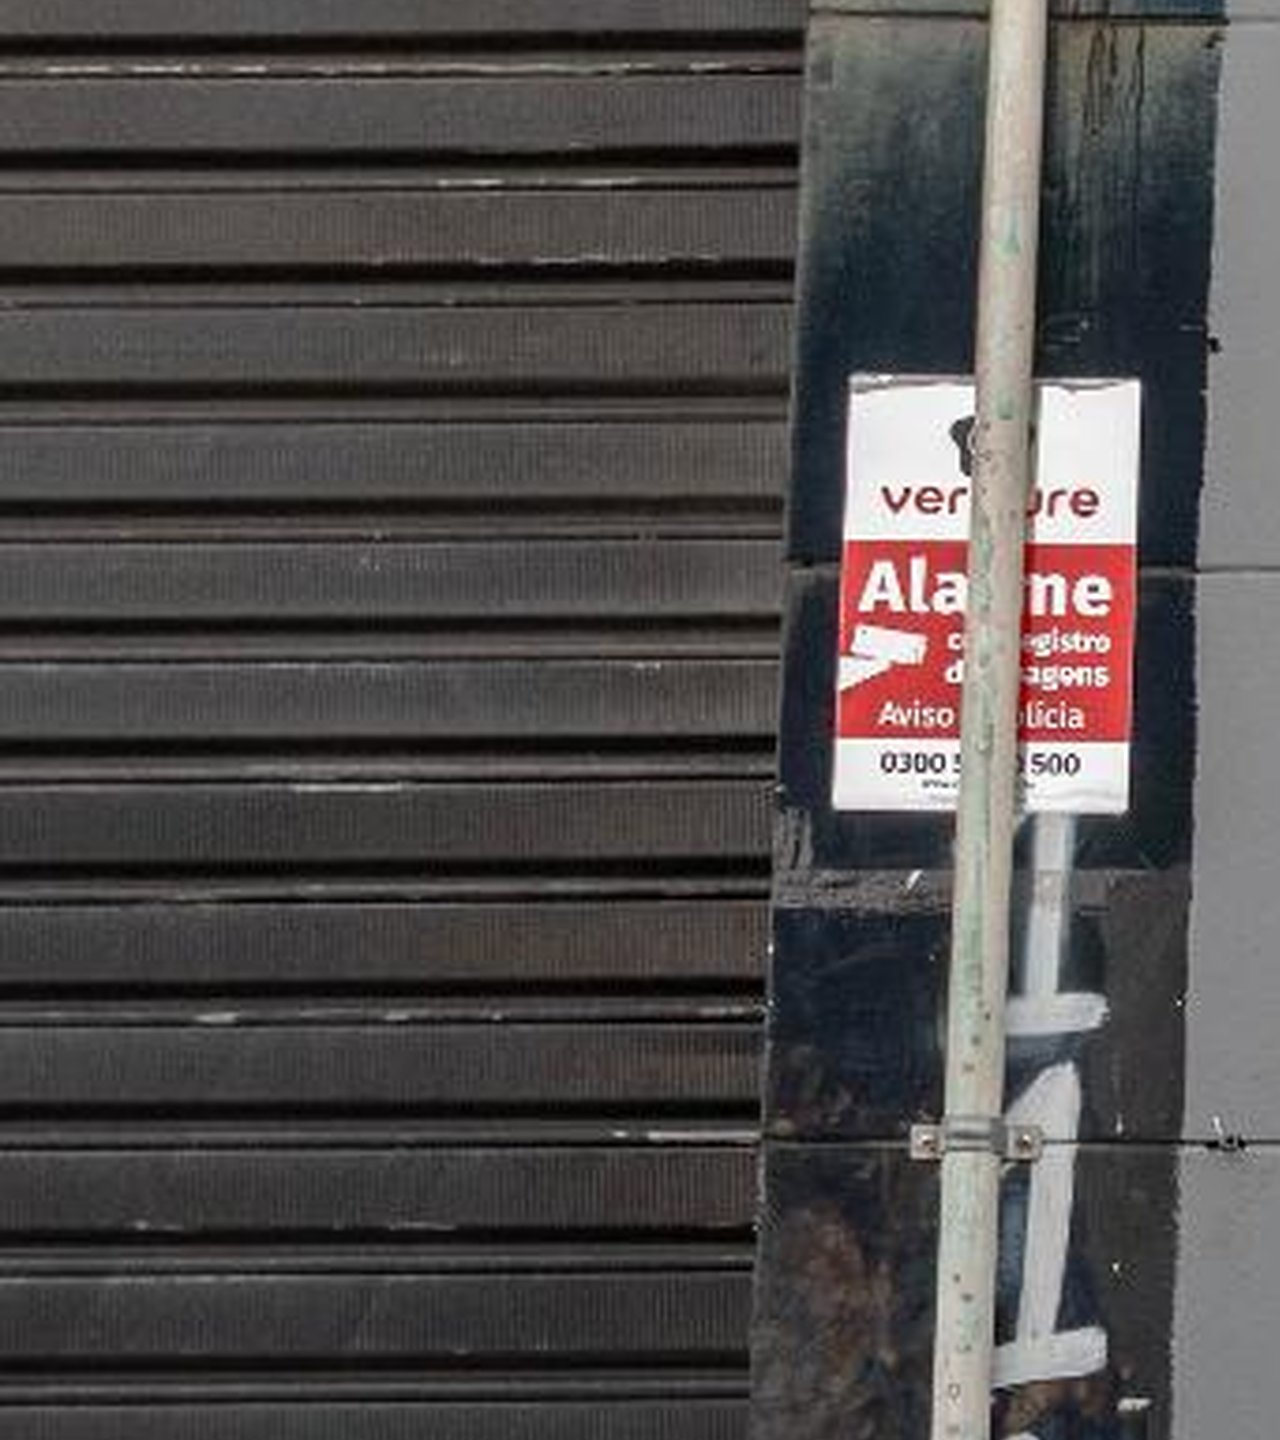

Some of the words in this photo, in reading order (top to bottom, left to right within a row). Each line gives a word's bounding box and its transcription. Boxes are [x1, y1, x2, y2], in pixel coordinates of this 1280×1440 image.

[882, 485, 1099, 518] verure
[878, 701, 954, 728] Aviso
[881, 753, 947, 774] 0300
